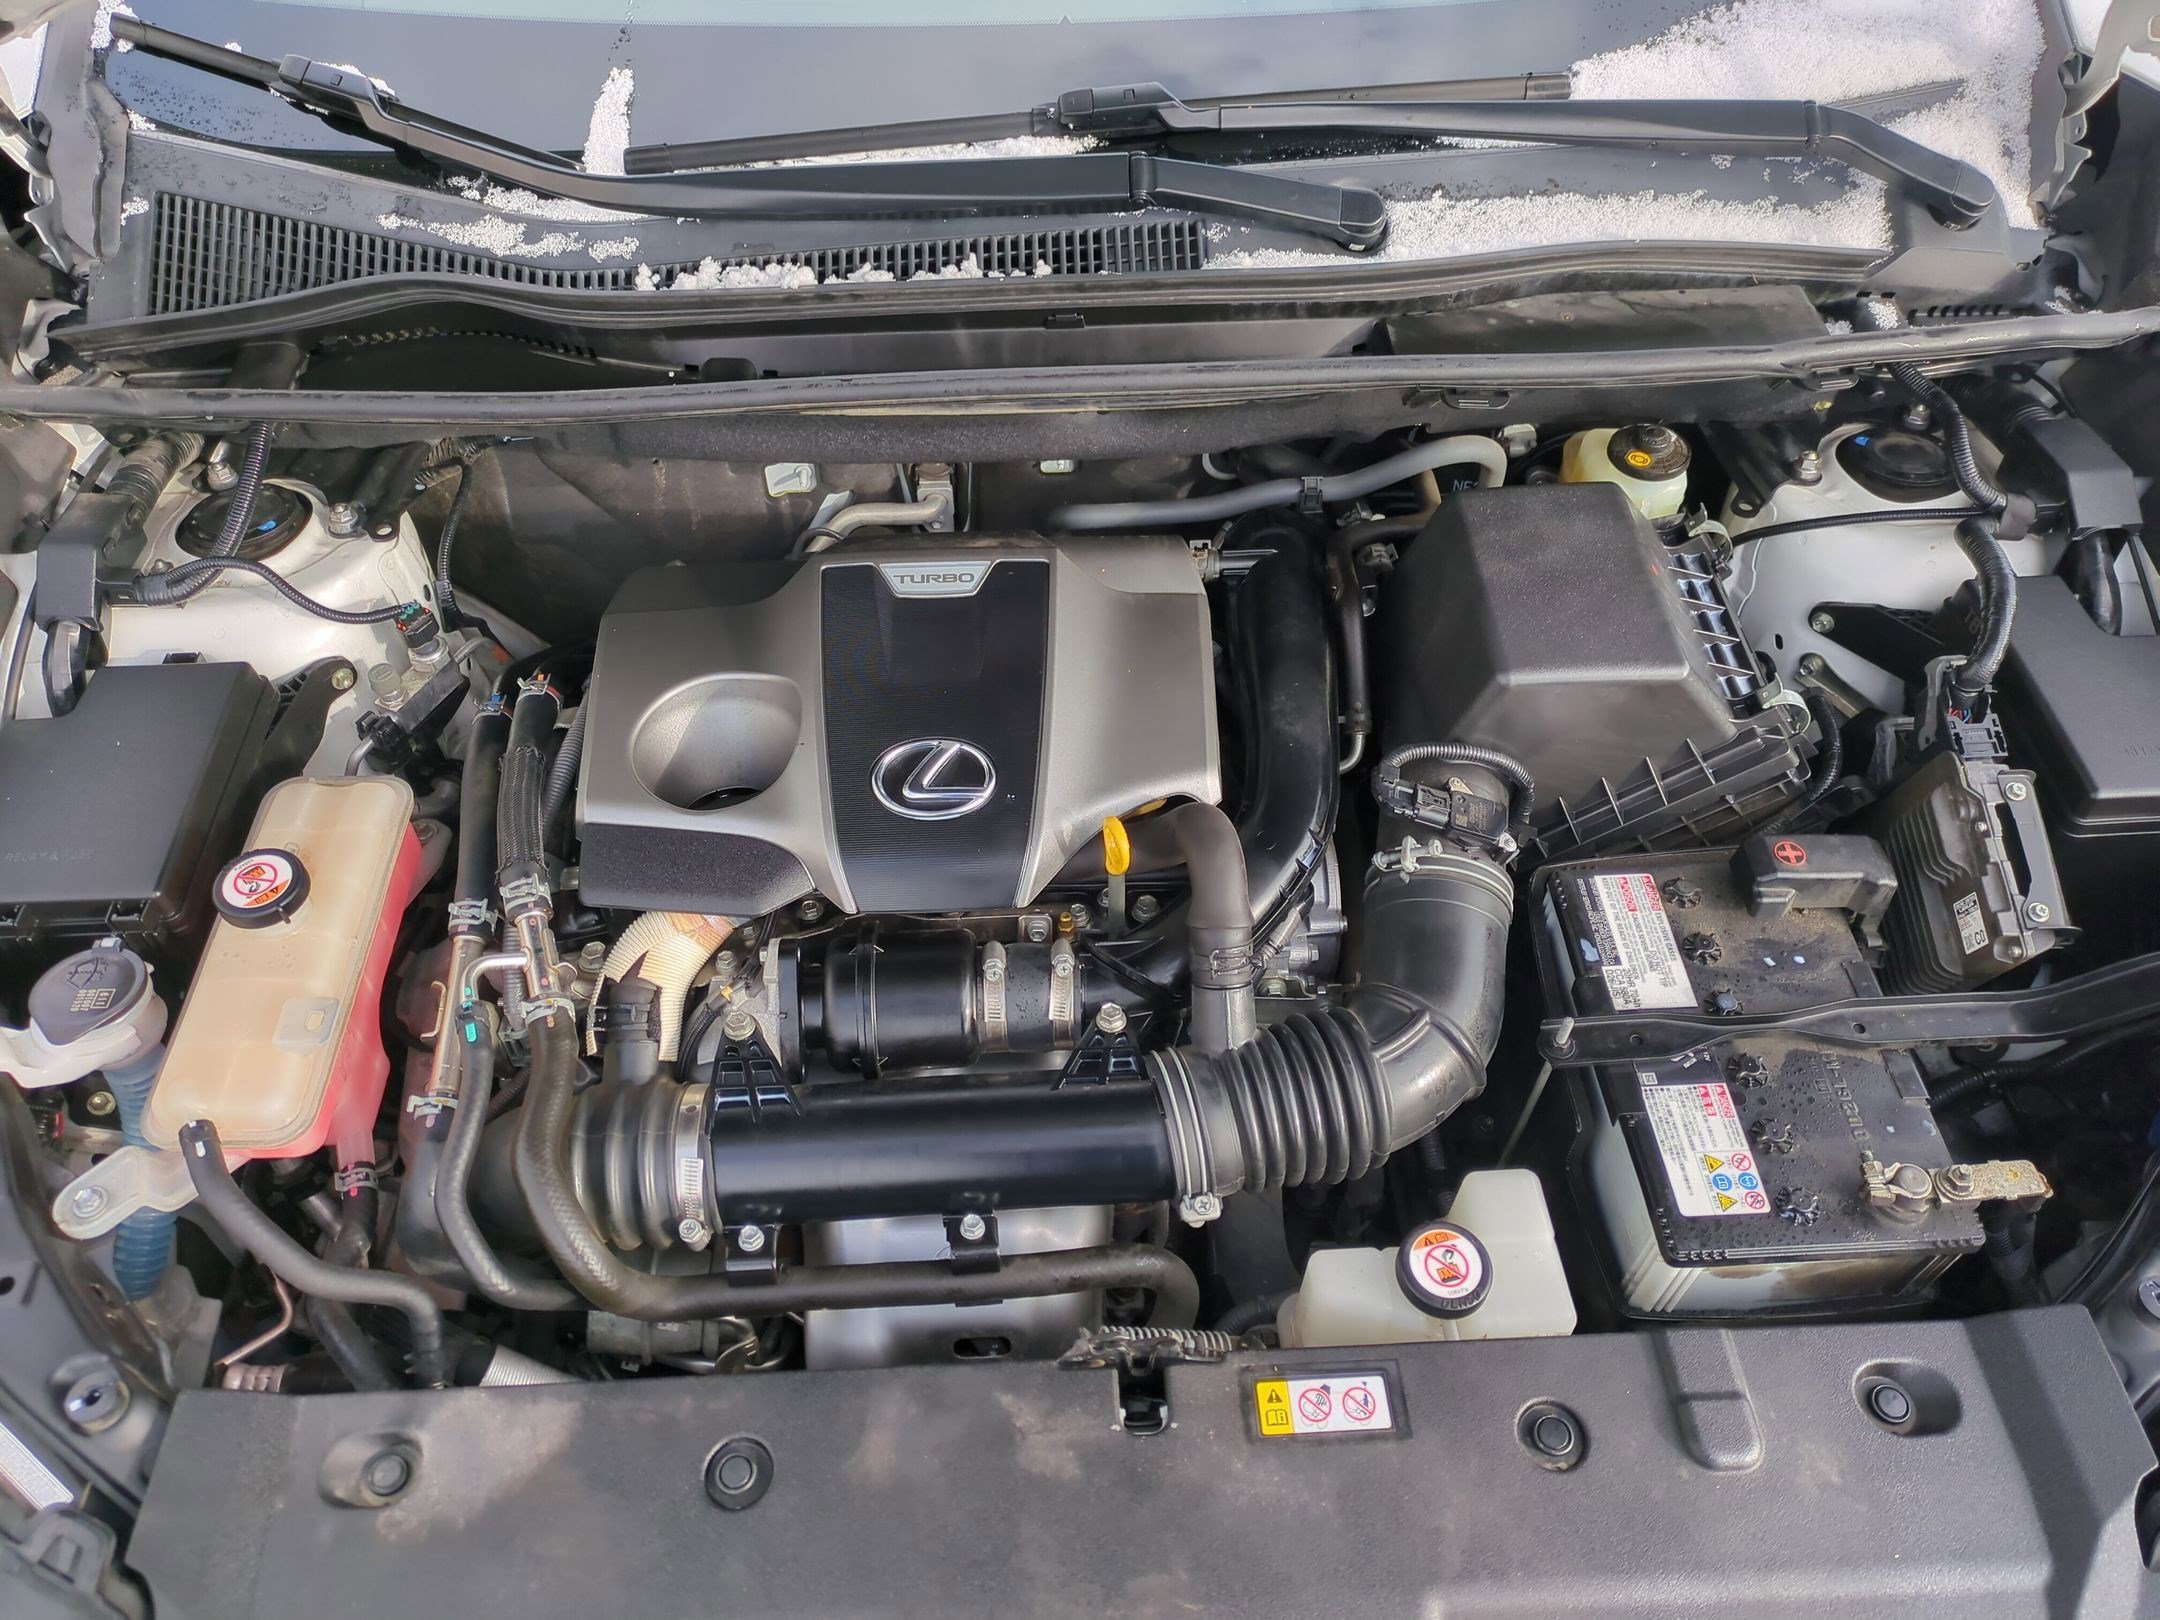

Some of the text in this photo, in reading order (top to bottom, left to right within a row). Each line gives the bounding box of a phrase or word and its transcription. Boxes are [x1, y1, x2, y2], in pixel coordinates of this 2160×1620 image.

[893, 572, 974, 584] TURBO
[1602, 877, 1610, 890] KEEP
[1623, 886, 1636, 909] POISON
[1632, 913, 1643, 933] CAUSES
[1639, 933, 1650, 953] SEVERE
[1655, 912, 1670, 942] EXPLOSIVE
[1666, 942, 1677, 961] GASES
[1614, 968, 1625, 984] CCA
[1620, 986, 1632, 1005] 580A
[1623, 967, 1635, 987] 20HR
[1717, 1094, 1734, 1118] DANGER
